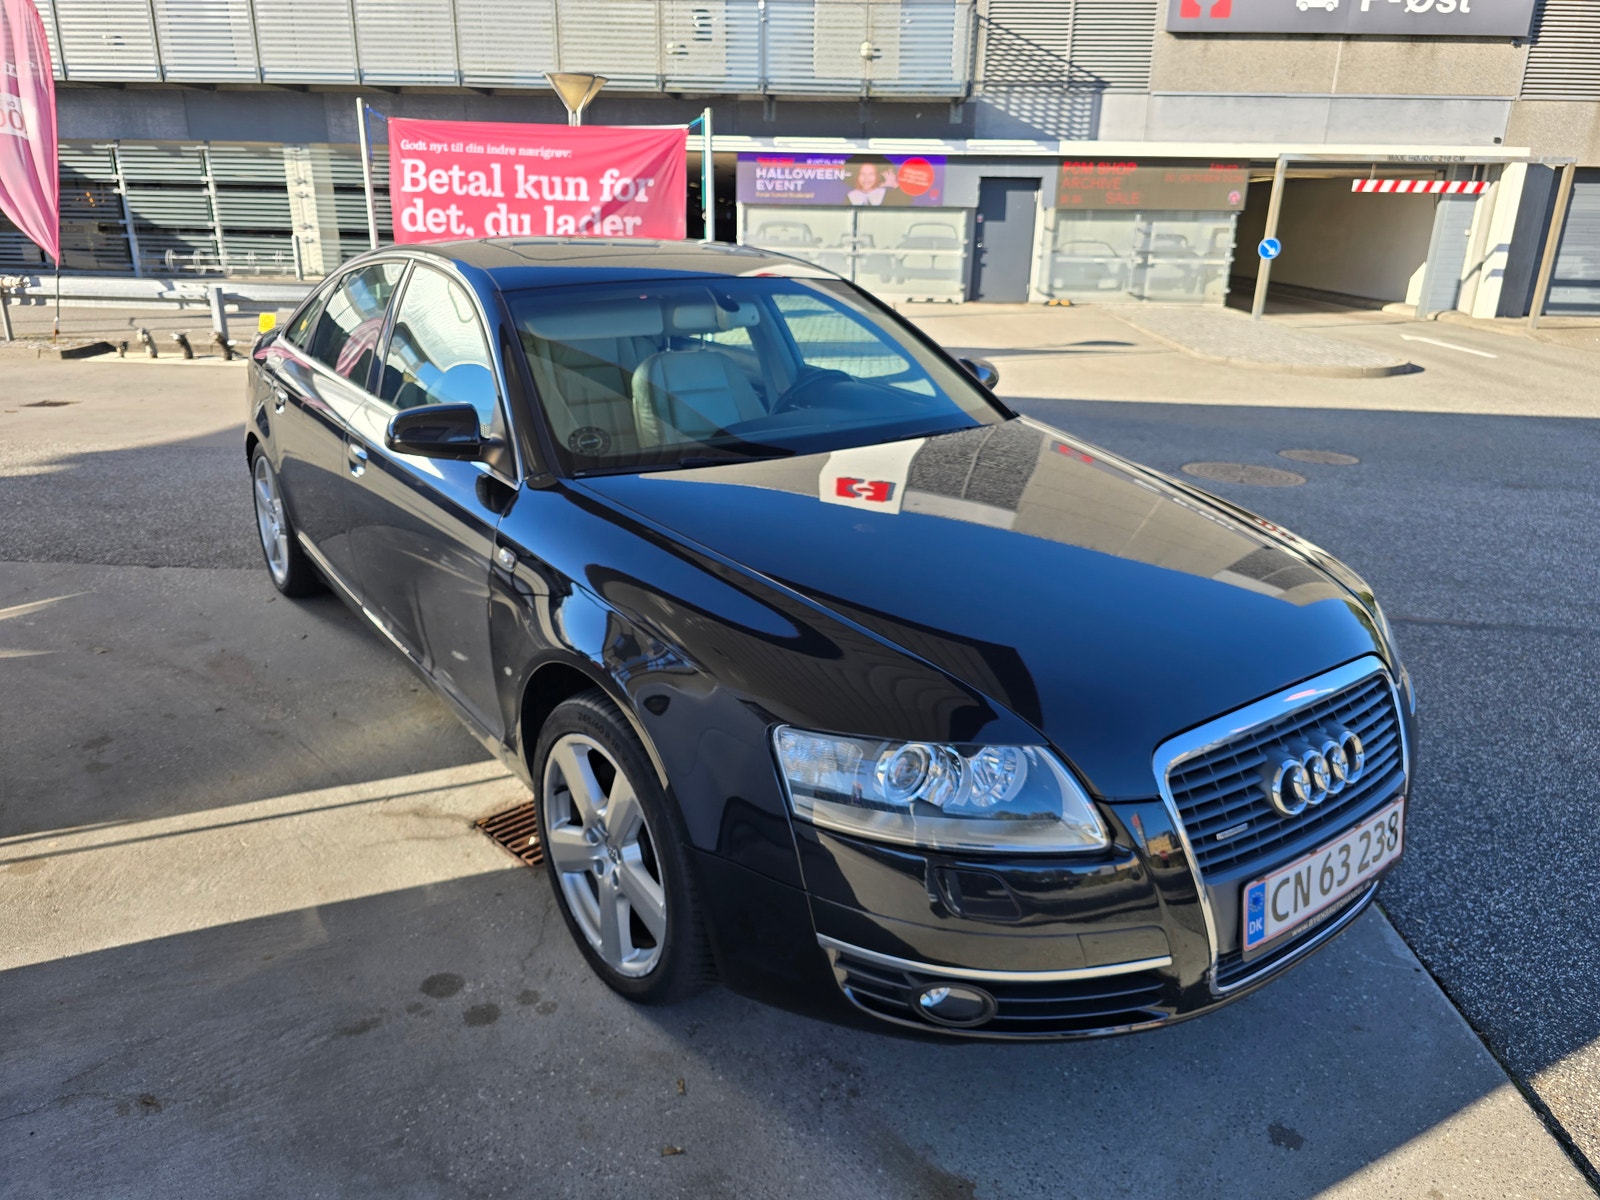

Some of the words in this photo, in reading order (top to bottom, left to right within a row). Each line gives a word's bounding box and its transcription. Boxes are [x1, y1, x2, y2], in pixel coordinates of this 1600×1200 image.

[400, 139, 427, 151] Godt
[429, 142, 448, 154] nyt
[451, 142, 464, 153] til
[465, 143, 484, 154] din
[486, 144, 516, 156] indre
[755, 167, 852, 180] HALLOWEEN-
[1097, 161, 1137, 175] SHOP
[400, 158, 505, 197] Betal
[514, 164, 590, 202] kun
[599, 168, 655, 202] for
[755, 179, 804, 191] EVENT
[1061, 176, 1121, 190] ARCHIVE
[1105, 191, 1140, 205] SALE
[401, 198, 475, 236] det,
[484, 203, 531, 236] du
[543, 205, 642, 236] lader
[1271, 865, 1311, 922] CN
[1319, 843, 1351, 896] 63
[1357, 810, 1399, 875] 238
[1249, 916, 1263, 935] DK
